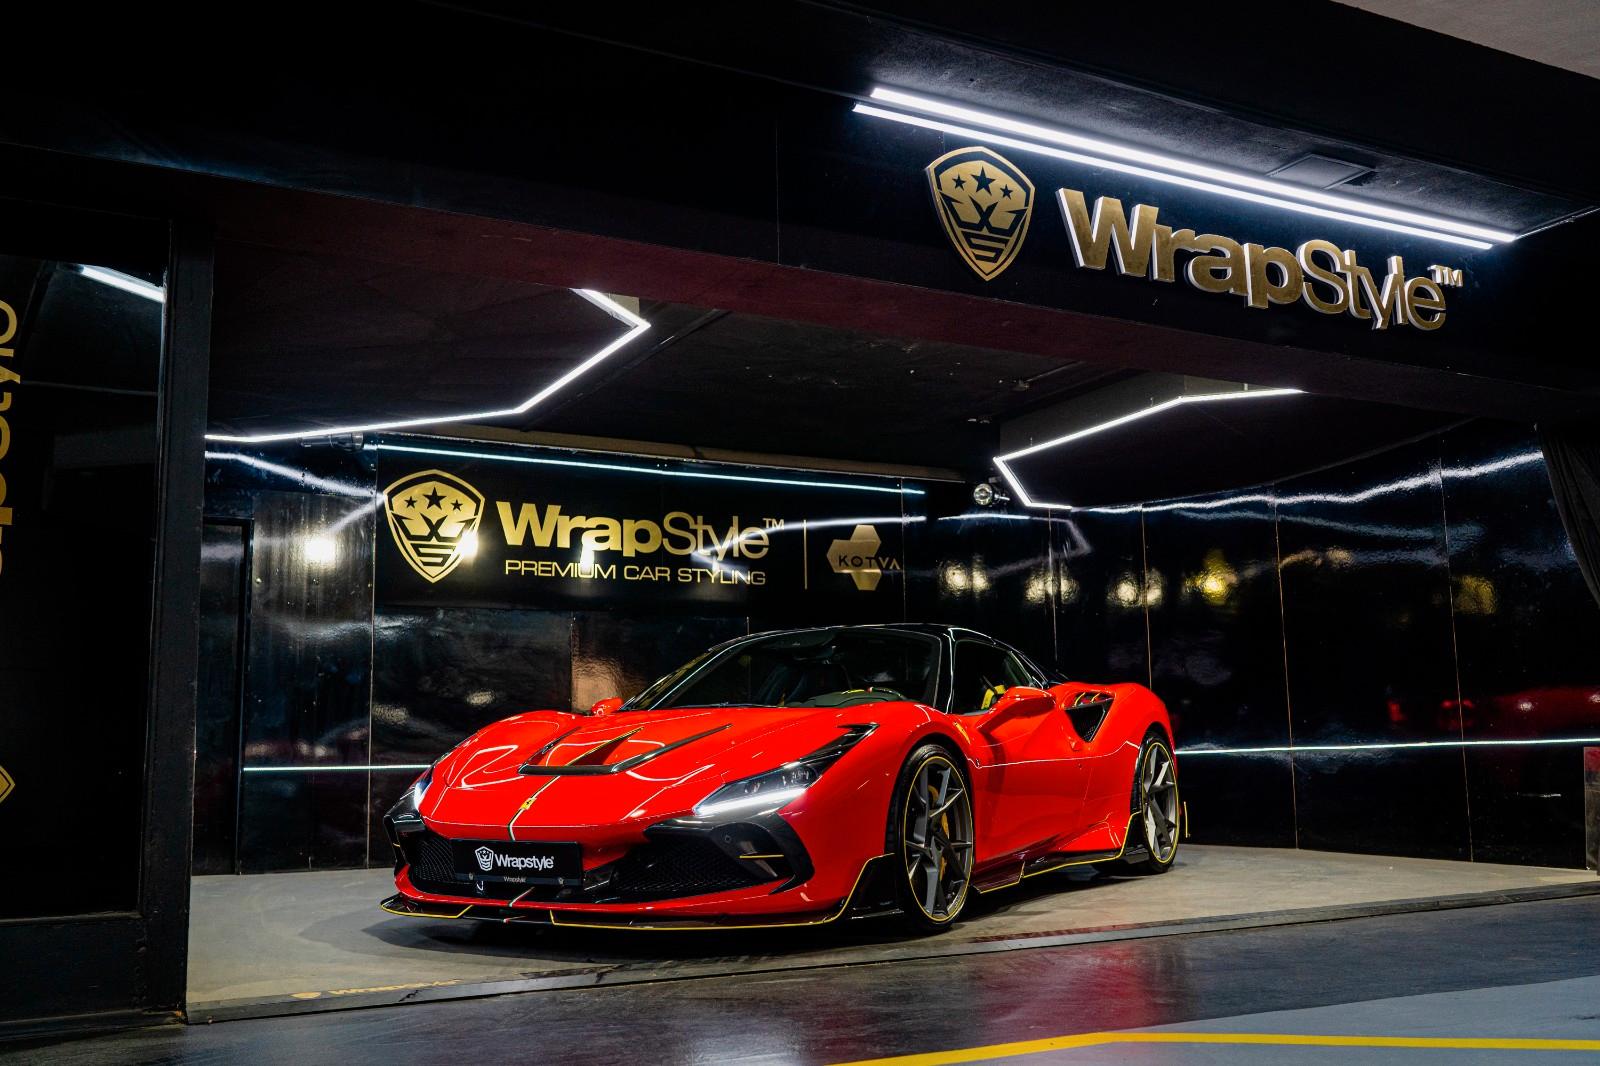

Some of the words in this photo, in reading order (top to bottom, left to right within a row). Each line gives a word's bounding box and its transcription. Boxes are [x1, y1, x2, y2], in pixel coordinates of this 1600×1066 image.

[506, 558, 616, 580] PREMIUM
[624, 565, 671, 583] CAR
[678, 567, 766, 586] STYLING
[838, 555, 901, 570] KOTVA
